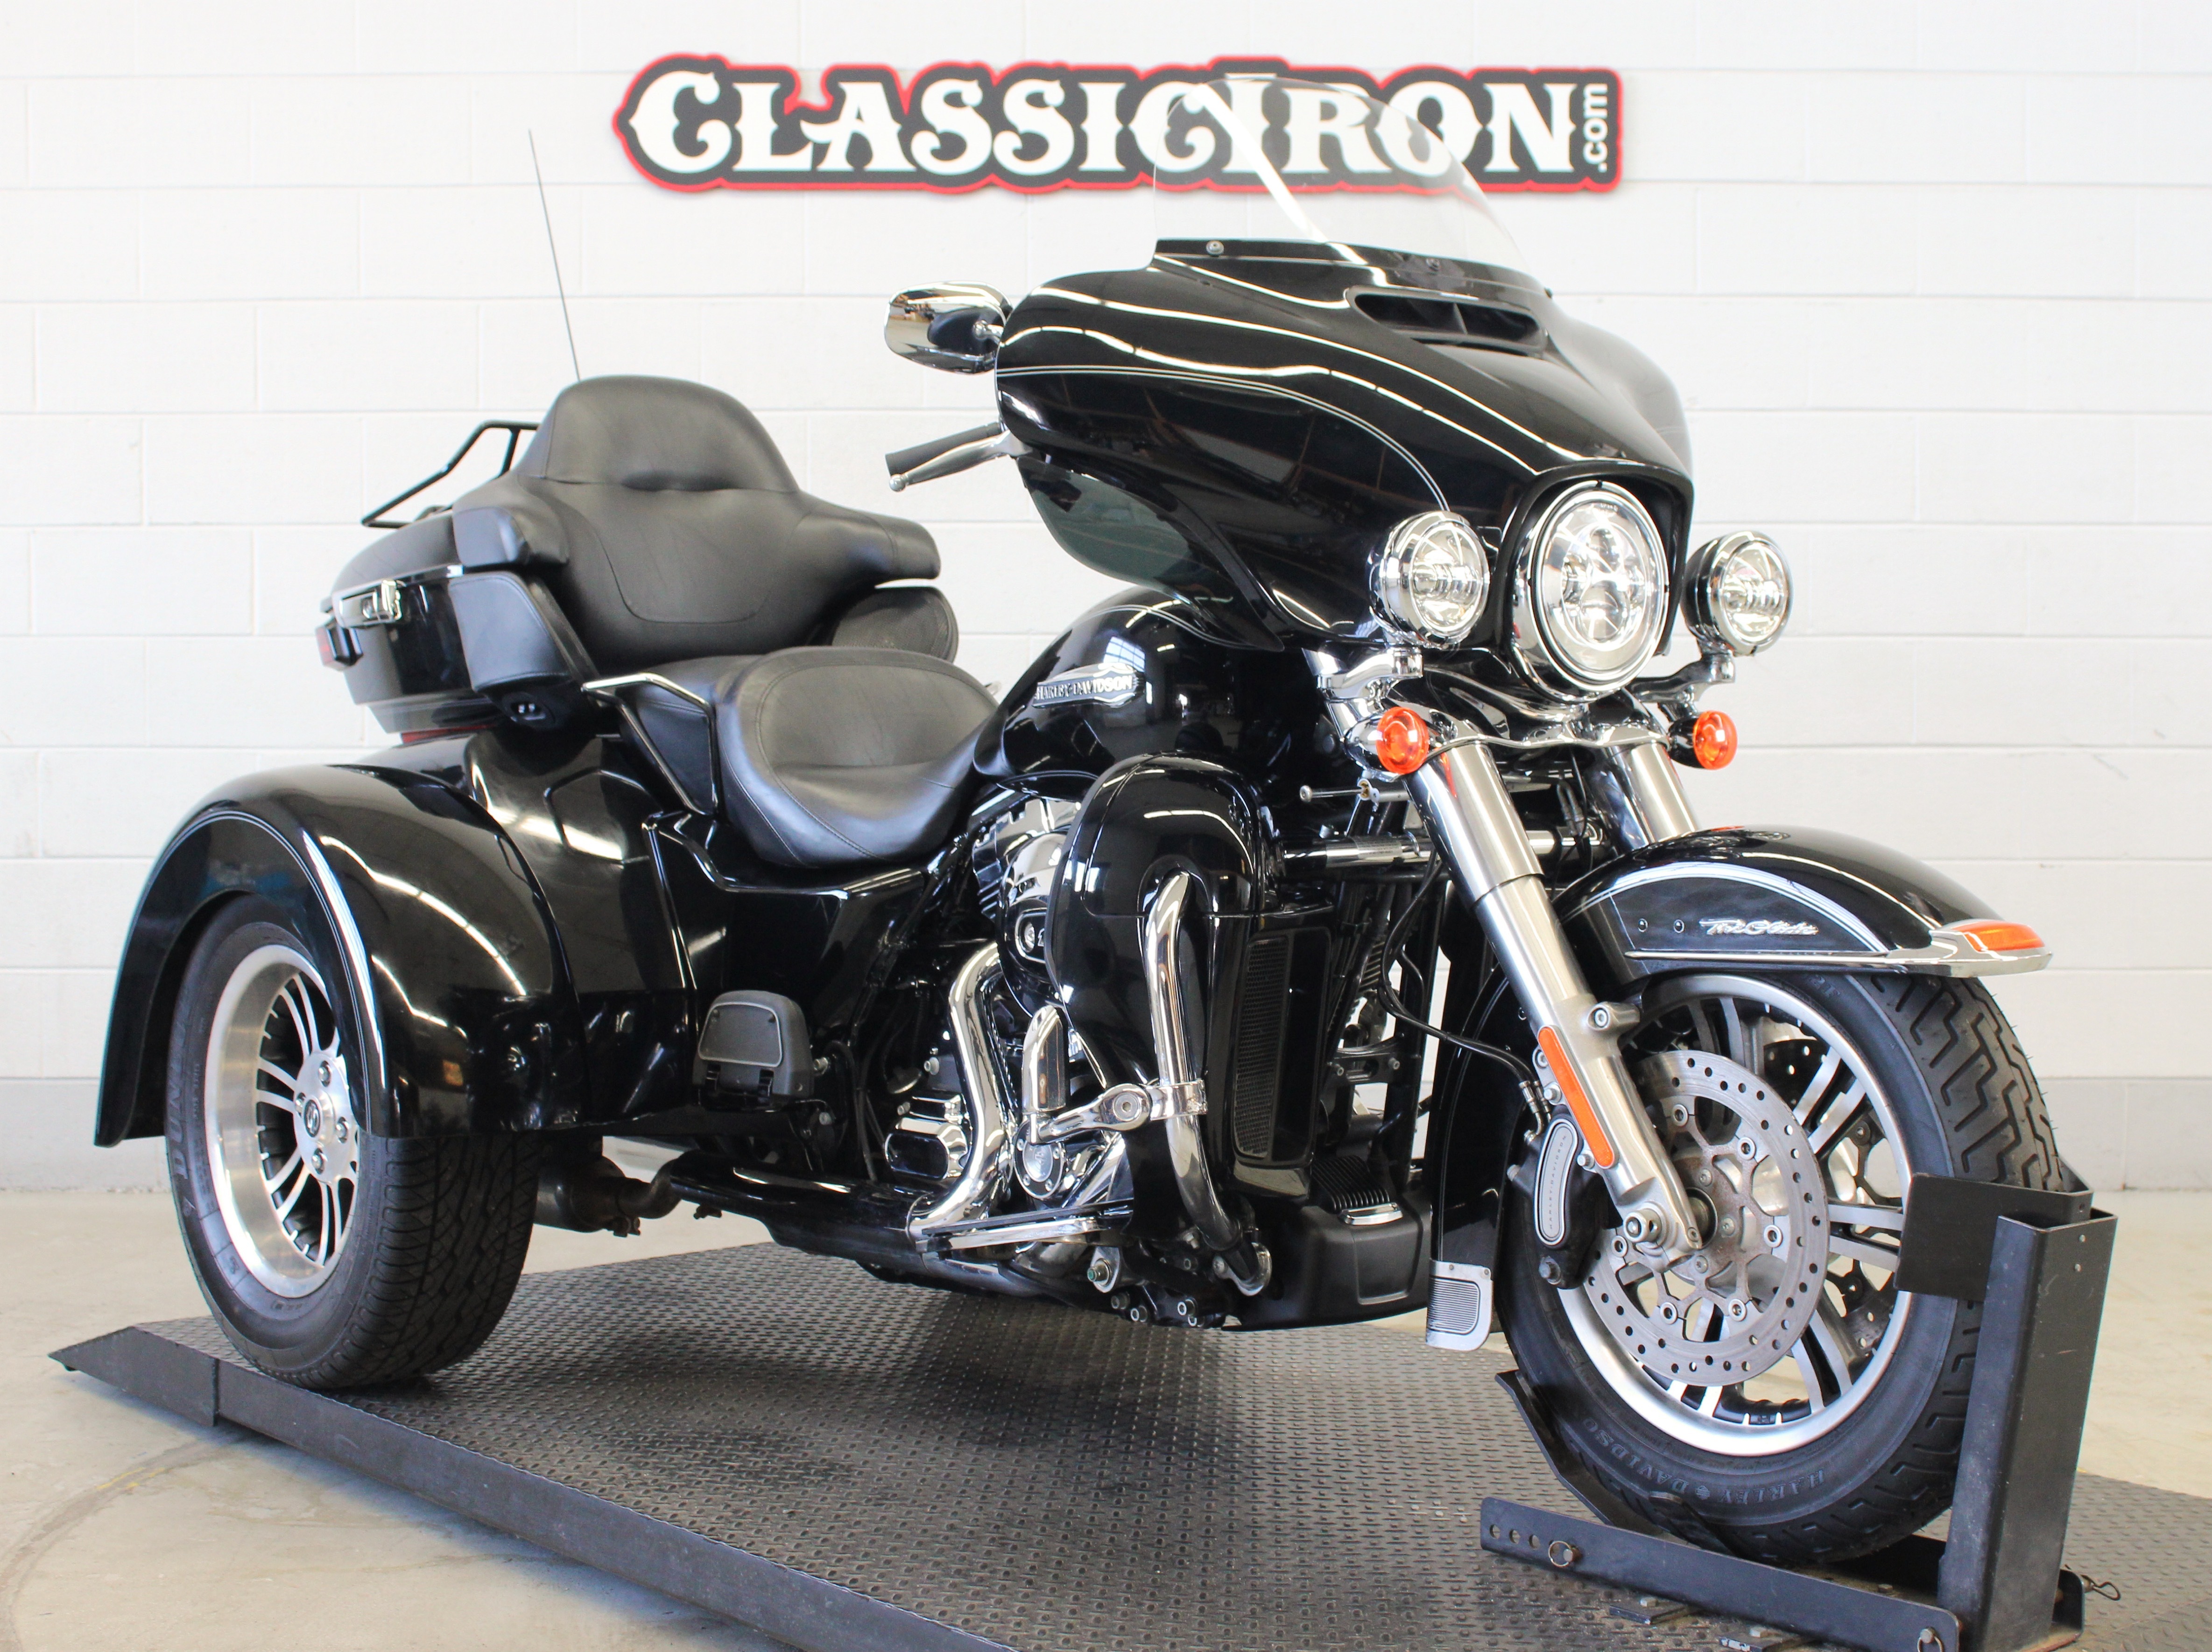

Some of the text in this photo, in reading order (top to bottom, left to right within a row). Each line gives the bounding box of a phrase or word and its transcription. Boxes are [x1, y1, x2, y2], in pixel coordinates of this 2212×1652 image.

[1582, 83, 1608, 173] .com
[1035, 675, 1133, 701] HARLEY-DAVIDSON
[1582, 1418, 1689, 1494] DAVIDSO
[1719, 1469, 1825, 1504] HARLEY
